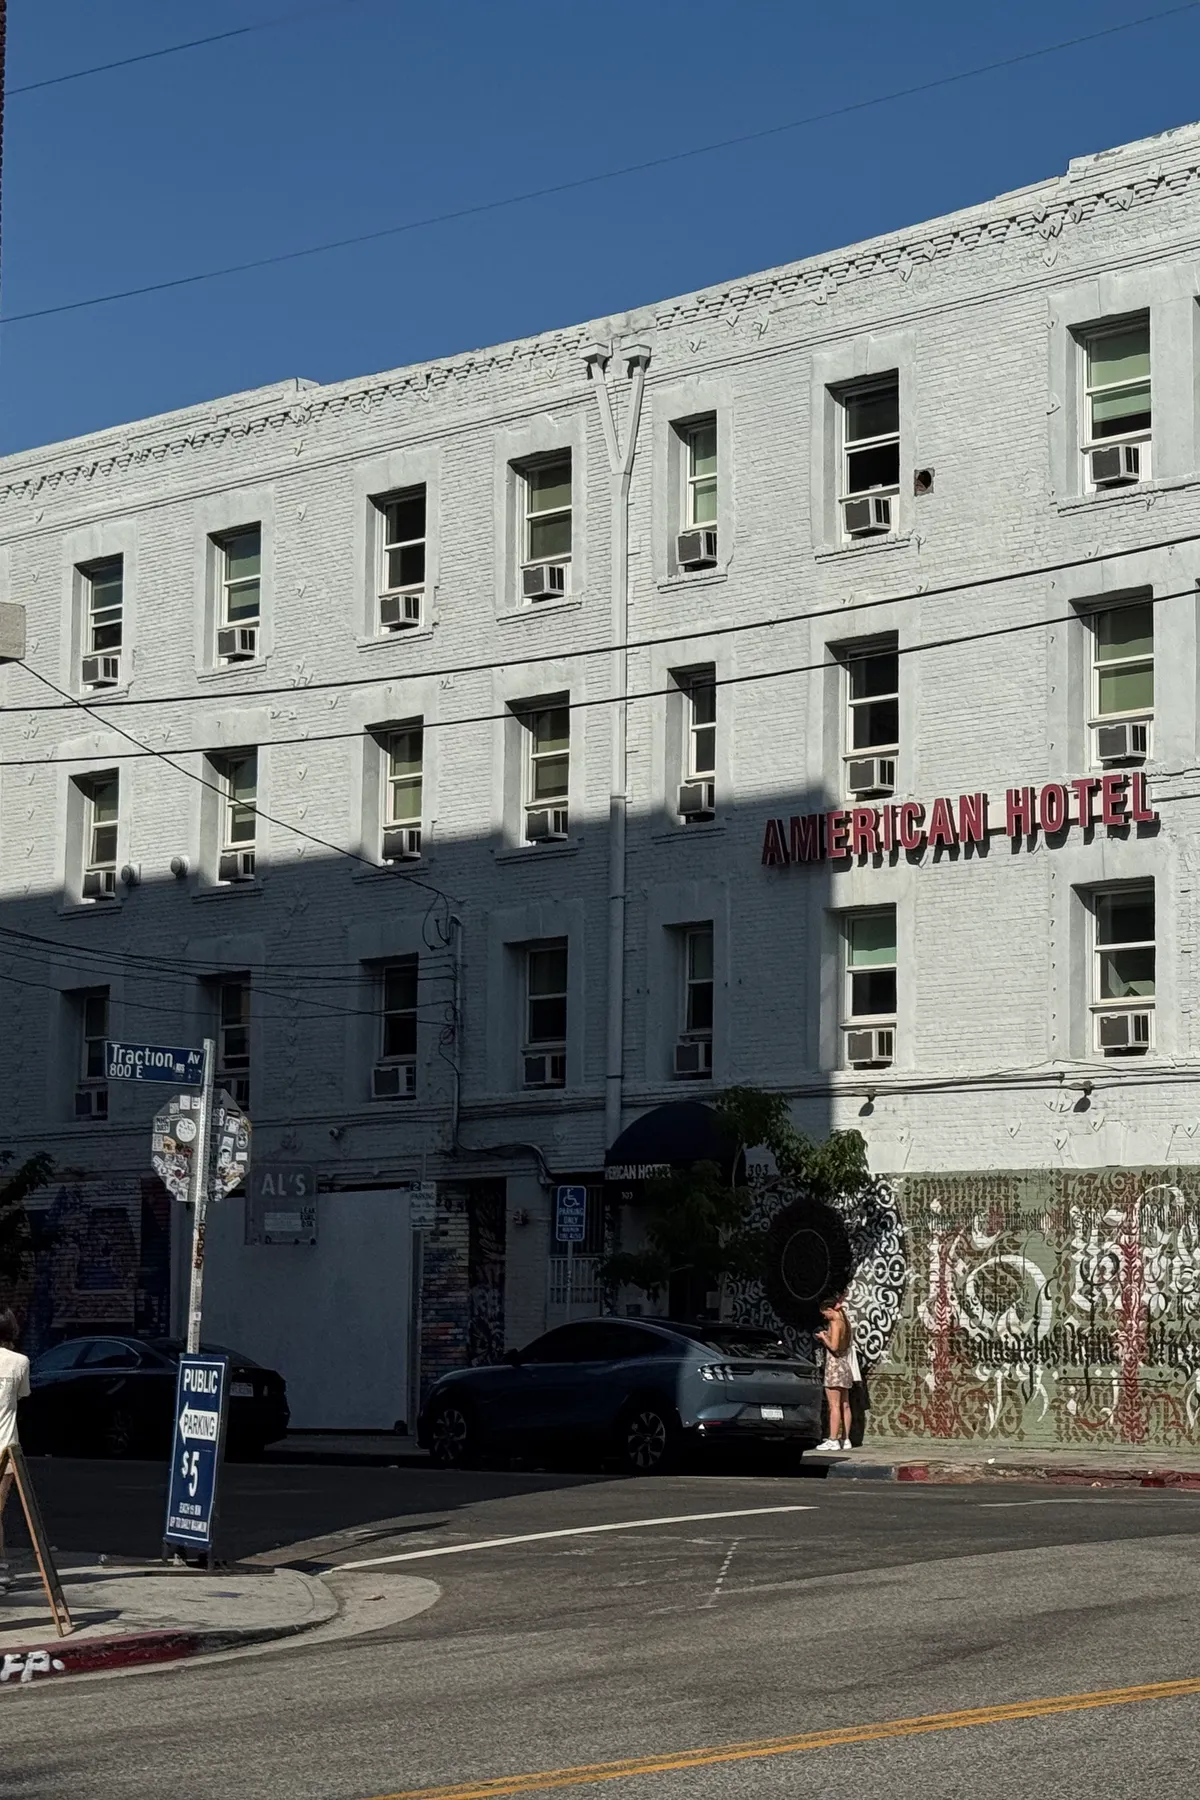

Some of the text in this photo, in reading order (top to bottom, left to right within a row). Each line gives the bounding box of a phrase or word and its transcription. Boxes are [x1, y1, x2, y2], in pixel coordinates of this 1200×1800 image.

[761, 771, 1157, 867] AMERICAN HOTEL
[112, 1044, 200, 1068] Traction Av
[109, 1064, 144, 1078] 800 E
[261, 1172, 306, 1196] AL'S
[559, 1207, 584, 1216] PARKING
[563, 1215, 578, 1224] ONLY
[183, 1368, 218, 1394] PUBLIC
[183, 1414, 216, 1437] PARKING
